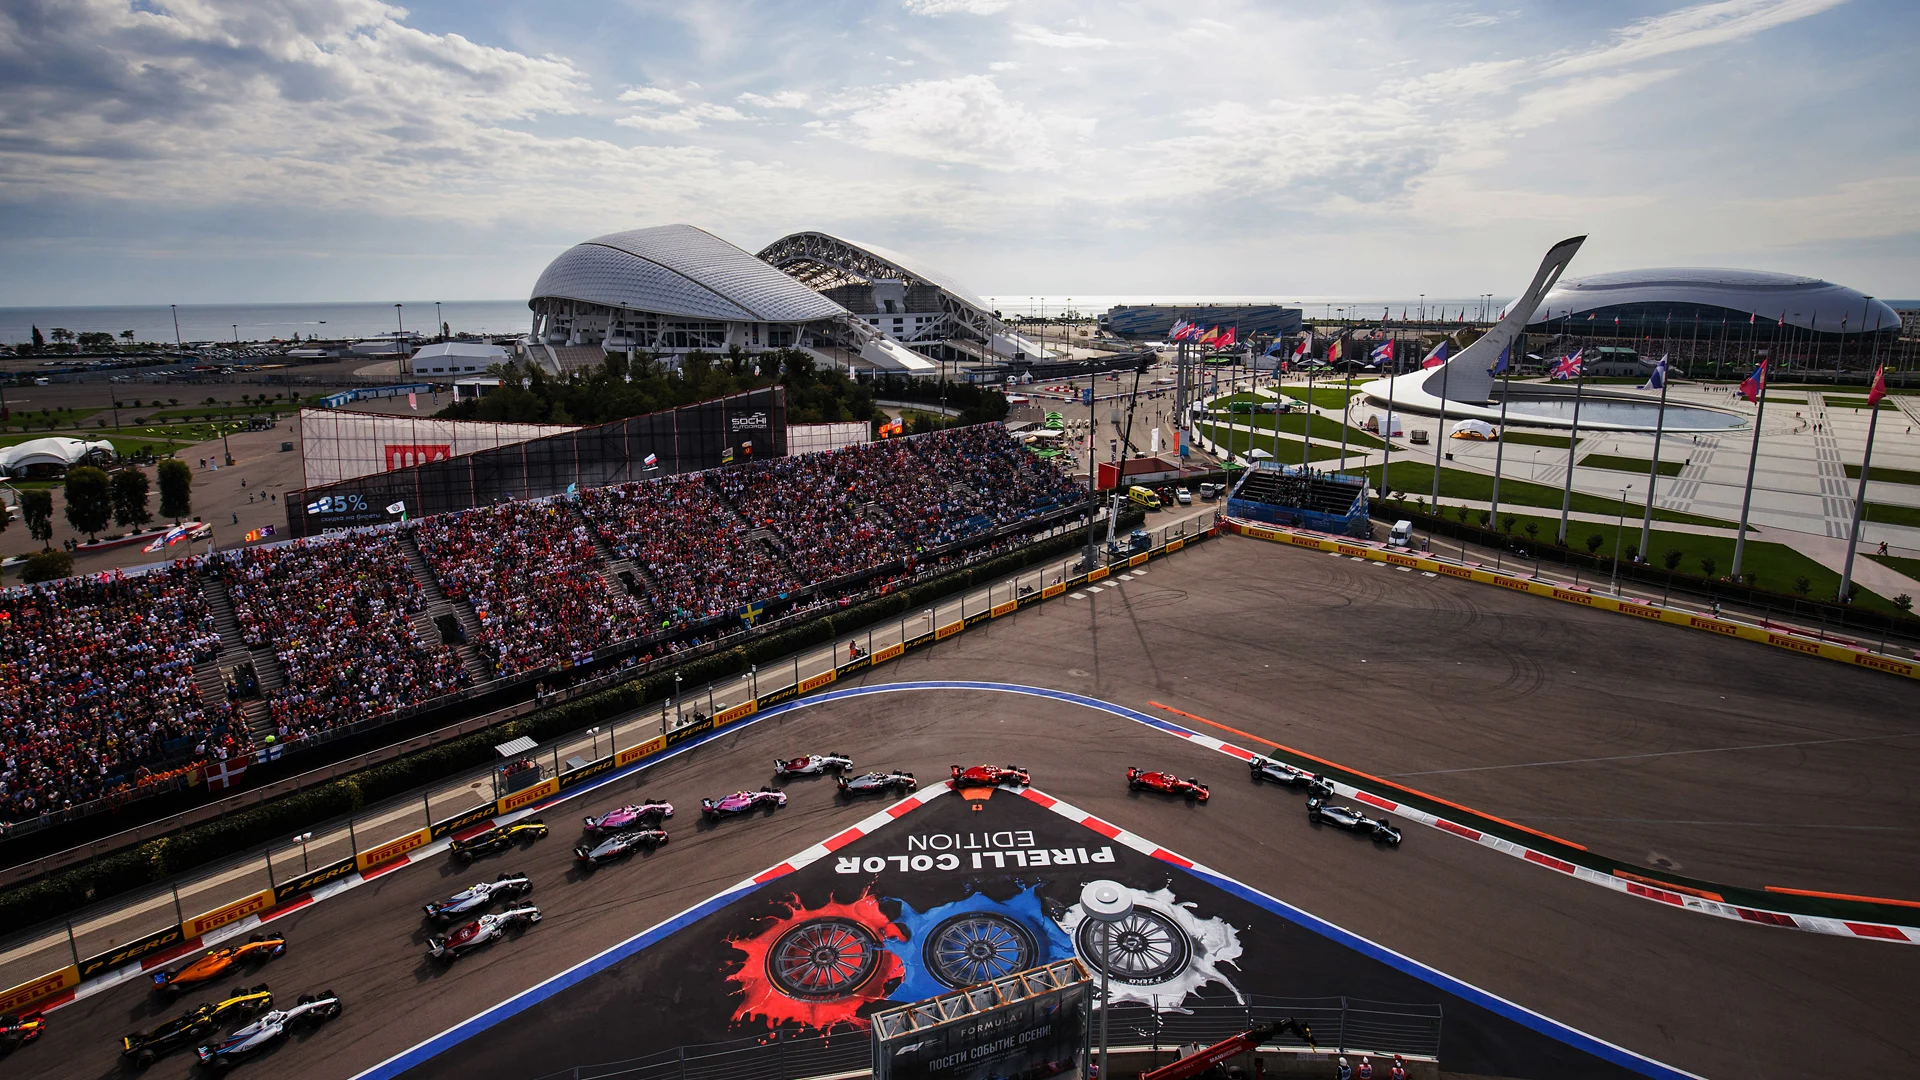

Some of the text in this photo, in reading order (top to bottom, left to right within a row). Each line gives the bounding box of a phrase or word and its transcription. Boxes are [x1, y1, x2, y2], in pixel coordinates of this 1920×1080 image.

[732, 417, 767, 425] SOCHI
[320, 494, 368, 513] 25%
[1249, 529, 1275, 539] PIRELLI
[1292, 536, 1320, 548] PIRELLI
[1338, 545, 1367, 557] PIRELLI
[1386, 554, 1417, 566] PIRELLI
[1090, 569, 1107, 580] PIRELLI
[1439, 565, 1471, 578] PIRELLI
[1044, 585, 1064, 597] PIRELLI
[1493, 577, 1529, 591] PIRELLI
[1553, 589, 1592, 604] PIRELLI
[972, 612, 990, 623] ZERO
[994, 603, 1015, 616] PIRELLI
[1619, 603, 1661, 618] PIRELLI
[939, 623, 961, 638] PIRELLI
[1690, 618, 1737, 634] PIRELLI
[913, 635, 934, 646] ZERO
[1769, 634, 1819, 653] PIRELLI
[876, 646, 900, 662] PIRELLI
[846, 659, 870, 672] ZERO
[1855, 653, 1912, 675] PIRELLI
[803, 673, 832, 691] PIRELLI
[769, 688, 796, 703] ZERO
[718, 704, 752, 723] PIRELLI
[679, 721, 711, 738] ZERO
[622, 740, 660, 763] PIRELLI
[562, 761, 612, 785] P ZERO
[505, 783, 551, 809] PIRELLI
[434, 807, 495, 836] P ZERO
[909, 830, 1035, 850] EDITION
[366, 834, 422, 864] PIRELLI
[834, 846, 1116, 874] PIRELLI COLOR
[279, 863, 354, 897] P ZERO
[194, 895, 264, 933] PIRELLI
[84, 932, 179, 975] P ZERO
[0, 975, 63, 1010] RELLI
[961, 1014, 1017, 1037] FORMULA
[929, 1050, 967, 1072] ПОСЕТИ
[970, 1036, 1015, 1059] СОБЫТИЕ
[1018, 1025, 1051, 1044] ОСЕНИ!
